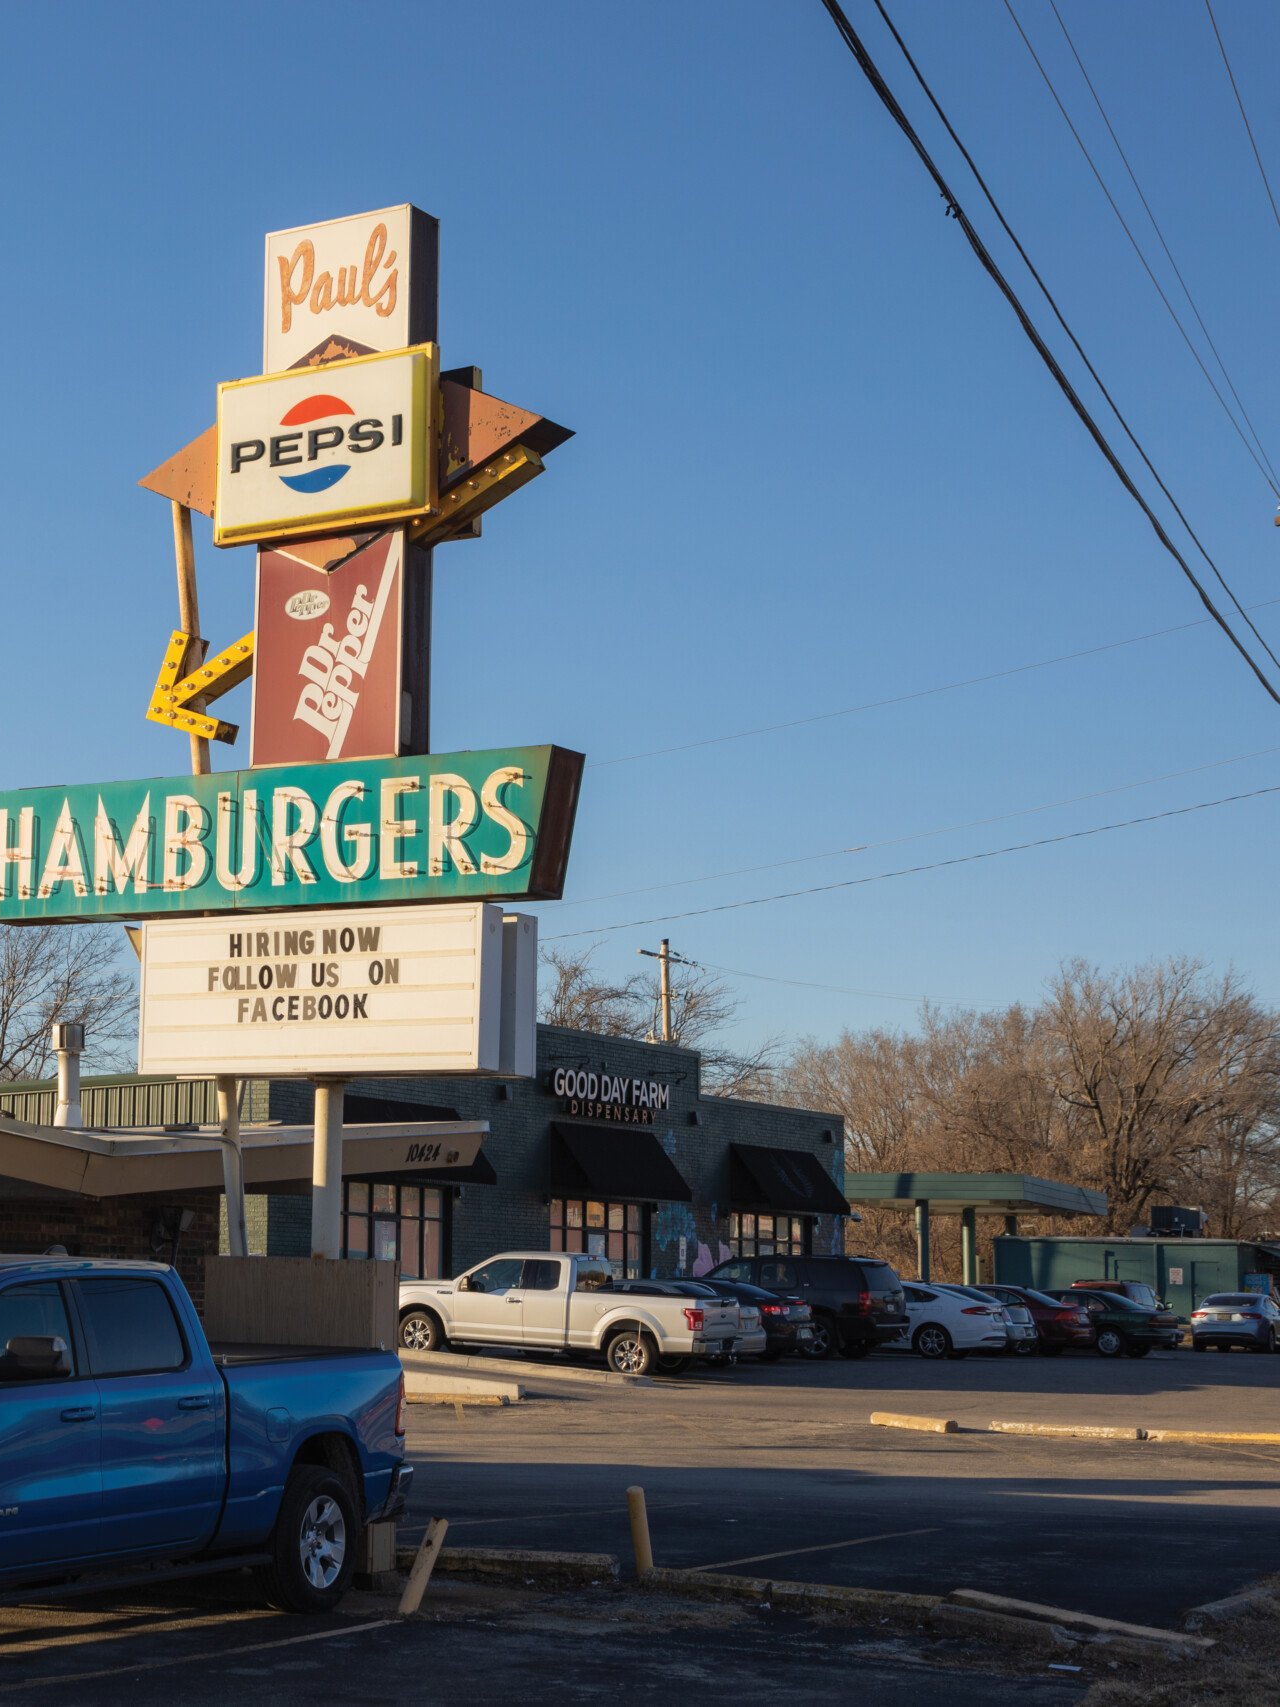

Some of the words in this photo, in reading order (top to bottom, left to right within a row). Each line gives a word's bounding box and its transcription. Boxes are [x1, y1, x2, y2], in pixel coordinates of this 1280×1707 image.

[277, 222, 398, 334] Paul's
[230, 413, 403, 474] PEPSI
[292, 583, 375, 746] Pepper
[298, 622, 341, 692] Dr
[229, 930, 315, 958] HIRING
[322, 926, 381, 955] NOW
[208, 963, 298, 992] FOLLOW
[311, 962, 340, 988] US
[368, 958, 400, 986] ON
[237, 993, 369, 1023] FACEBOOK
[554, 1067, 599, 1100] GOOD
[601, 1075, 629, 1105] DAY
[632, 1079, 670, 1110] FARM
[571, 1099, 657, 1125] DISPENSARY
[405, 1143, 441, 1162] 10424
